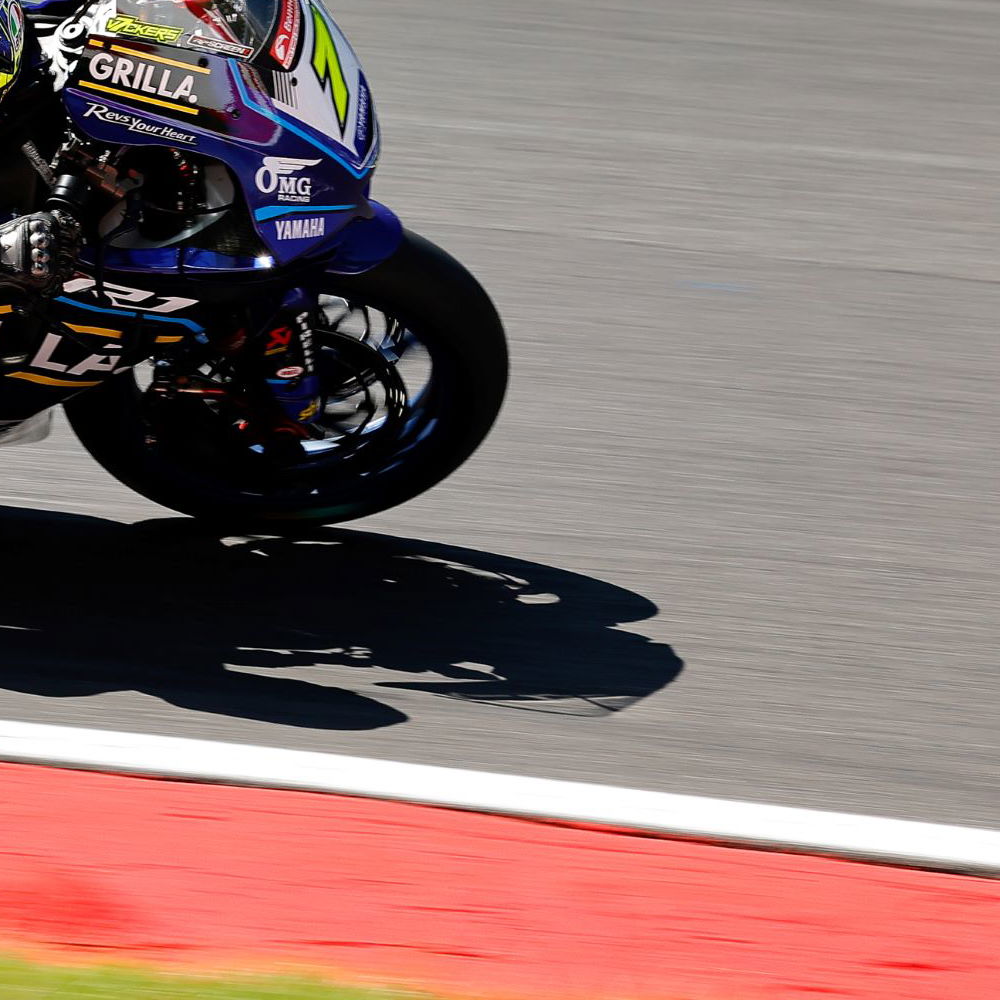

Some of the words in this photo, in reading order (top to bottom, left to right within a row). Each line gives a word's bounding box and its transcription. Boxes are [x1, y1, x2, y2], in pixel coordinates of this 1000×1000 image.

[88, 52, 198, 104] GRILLA.
[83, 101, 132, 129] Revs
[128, 117, 162, 132] Your
[160, 126, 197, 143] Heart
[254, 156, 323, 195] OMG
[277, 194, 311, 203] RACING
[275, 217, 325, 241] YAMAHA
